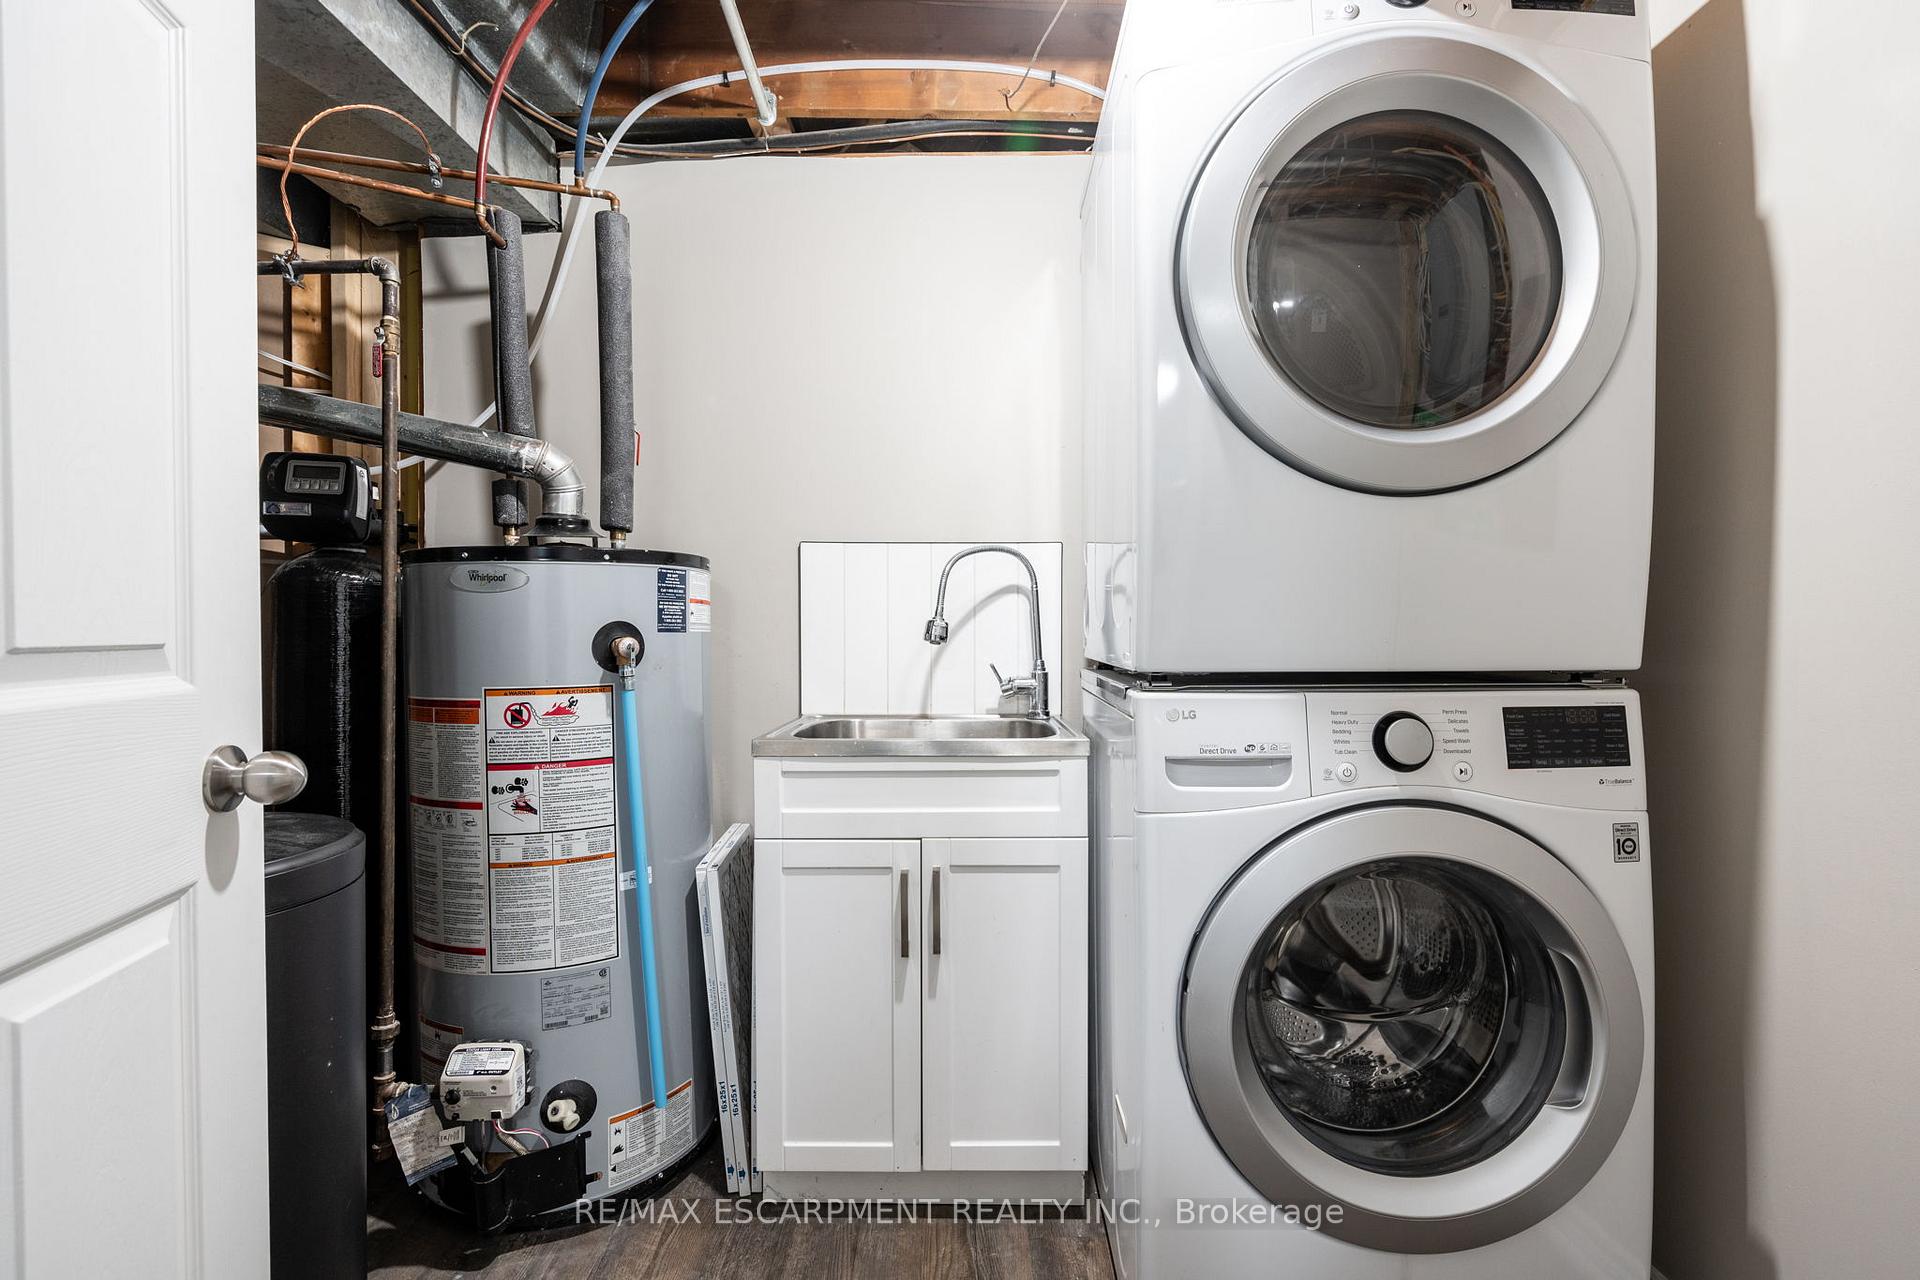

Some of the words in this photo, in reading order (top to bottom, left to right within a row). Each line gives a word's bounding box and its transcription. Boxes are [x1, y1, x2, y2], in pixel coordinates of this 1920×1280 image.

[468, 573, 508, 583] Whirlpool
[1182, 710, 1197, 720] LG
[1199, 747, 1219, 755] Direct
[1220, 747, 1237, 755] Drive
[1616, 837, 1637, 855] 10
[718, 1080, 728, 1113] 16x25x1
[730, 1084, 740, 1116] 16x25x1
